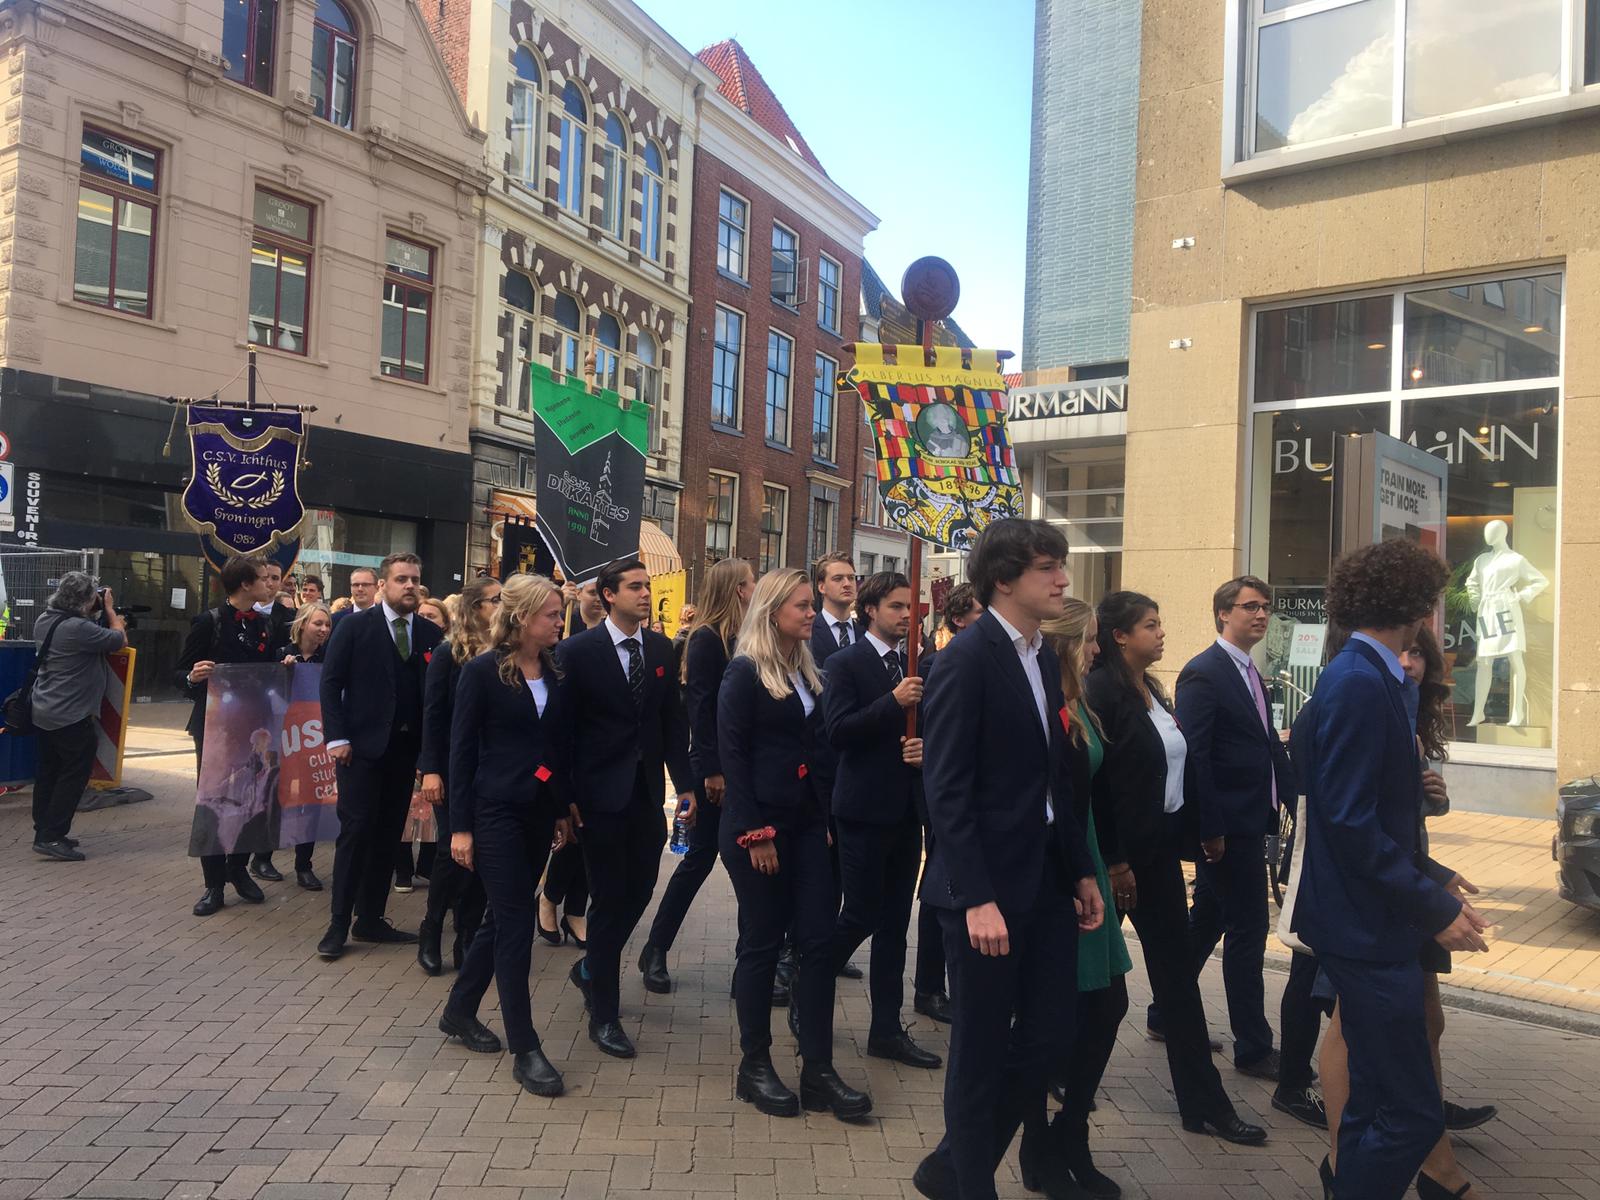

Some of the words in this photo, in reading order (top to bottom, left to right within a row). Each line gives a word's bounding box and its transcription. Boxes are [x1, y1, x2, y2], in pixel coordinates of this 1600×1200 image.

[862, 370, 932, 382] ALBERTUS
[940, 374, 1001, 387] MAGNUS
[202, 450, 236, 463] C.S.V.
[240, 453, 288, 470] Ichthus
[1380, 468, 1405, 491] TRAIN
[1406, 478, 1428, 500] MORE.
[1380, 487, 1396, 506] GET
[214, 507, 275, 529] Groningen
[568, 506, 590, 520] ANNO
[1298, 633, 1318, 642] 20%
[1443, 610, 1516, 650] SALE
